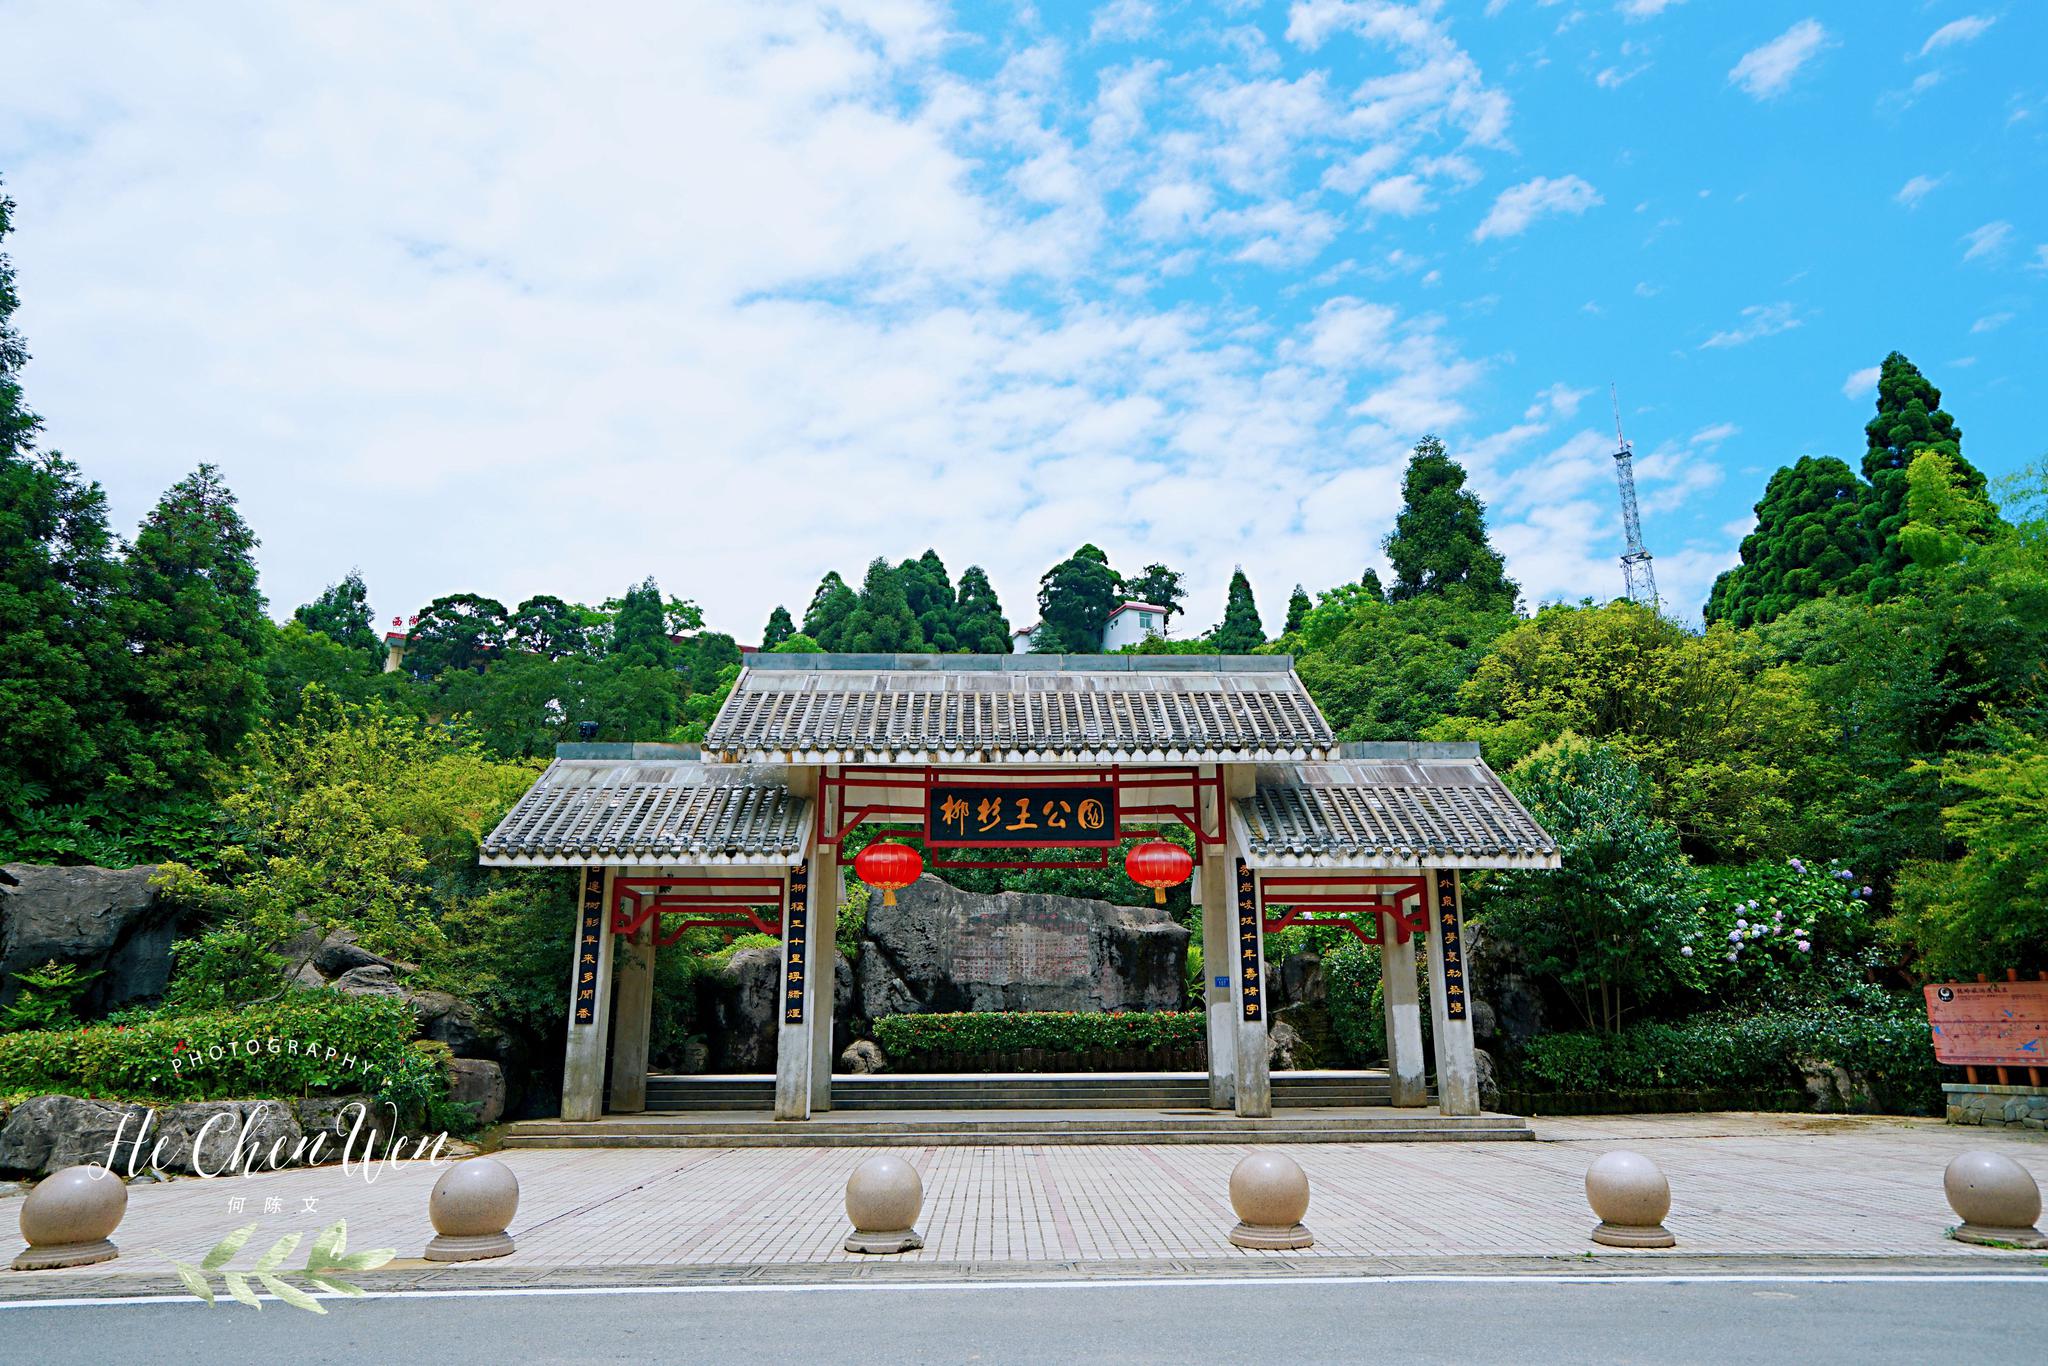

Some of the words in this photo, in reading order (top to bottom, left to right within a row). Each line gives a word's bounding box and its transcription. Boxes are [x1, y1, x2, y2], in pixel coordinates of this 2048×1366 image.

[940, 794, 1105, 836] 柳杉王公园
